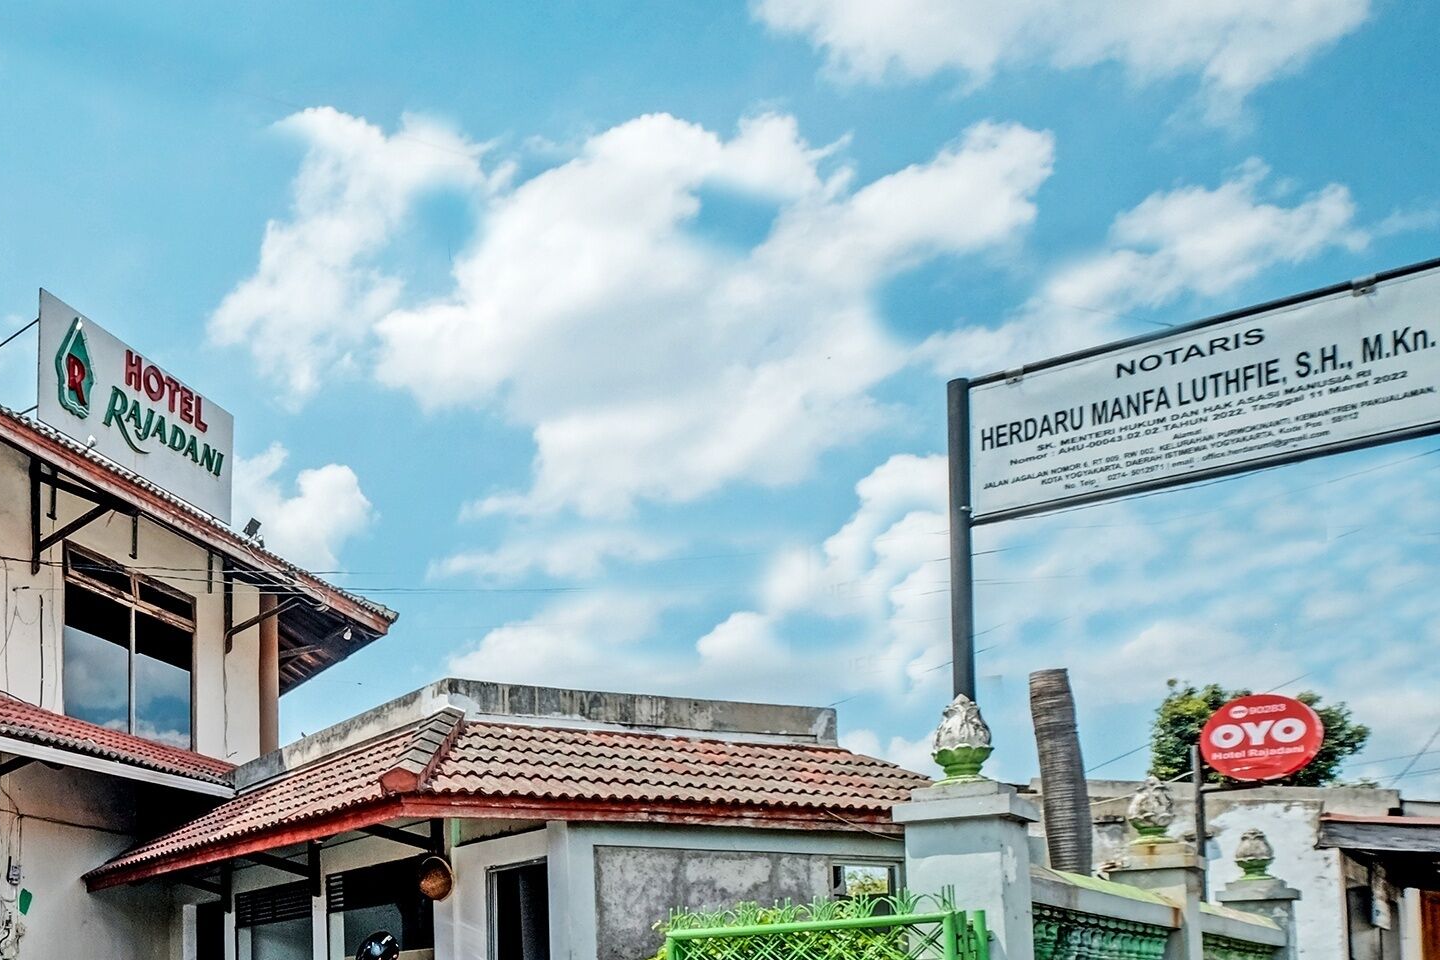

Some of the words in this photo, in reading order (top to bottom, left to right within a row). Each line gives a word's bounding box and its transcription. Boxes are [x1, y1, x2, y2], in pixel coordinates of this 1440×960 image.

[1116, 328, 1265, 378] NOTARIS
[124, 349, 208, 433] HOTEL
[981, 405, 1084, 451] HERDARU
[1092, 386, 1171, 427] MANFA
[1178, 358, 1287, 407] LUTHFIE,
[1296, 344, 1353, 378] S.H.,
[1362, 326, 1436, 364] M.Kn.
[1010, 452, 1048, 466] Nomor
[1163, 415, 1209, 431] TAHUN
[1251, 394, 1304, 412] Tanggal
[1309, 390, 1321, 399] 11
[1328, 380, 1369, 394] Maret
[1373, 370, 1408, 385] 2022
[1037, 442, 1056, 451] SK.
[1060, 428, 1116, 446] MENTERI
[1120, 416, 1167, 432] HUKUM
[1172, 407, 1199, 421] DAN
[1204, 402, 1232, 415] HAK
[1238, 390, 1280, 406] ASASI
[1285, 374, 1352, 394] MANUSIA
[1357, 369, 1372, 378] RI
[102, 385, 224, 477] RAJADANI
[983, 478, 1009, 490] JALAN
[1050, 463, 1081, 474] NOMOR
[1123, 450, 1138, 459] RW
[1158, 434, 1217, 452] KELURAHAN
[1041, 476, 1063, 486] KOTA
[1125, 454, 1162, 468] DAERAH
[1164, 443, 1209, 459] ISTIMEWA
[1209, 717, 1307, 749] OYO
[1211, 750, 1245, 760] Hotel
[1247, 745, 1304, 757] Rajadani
